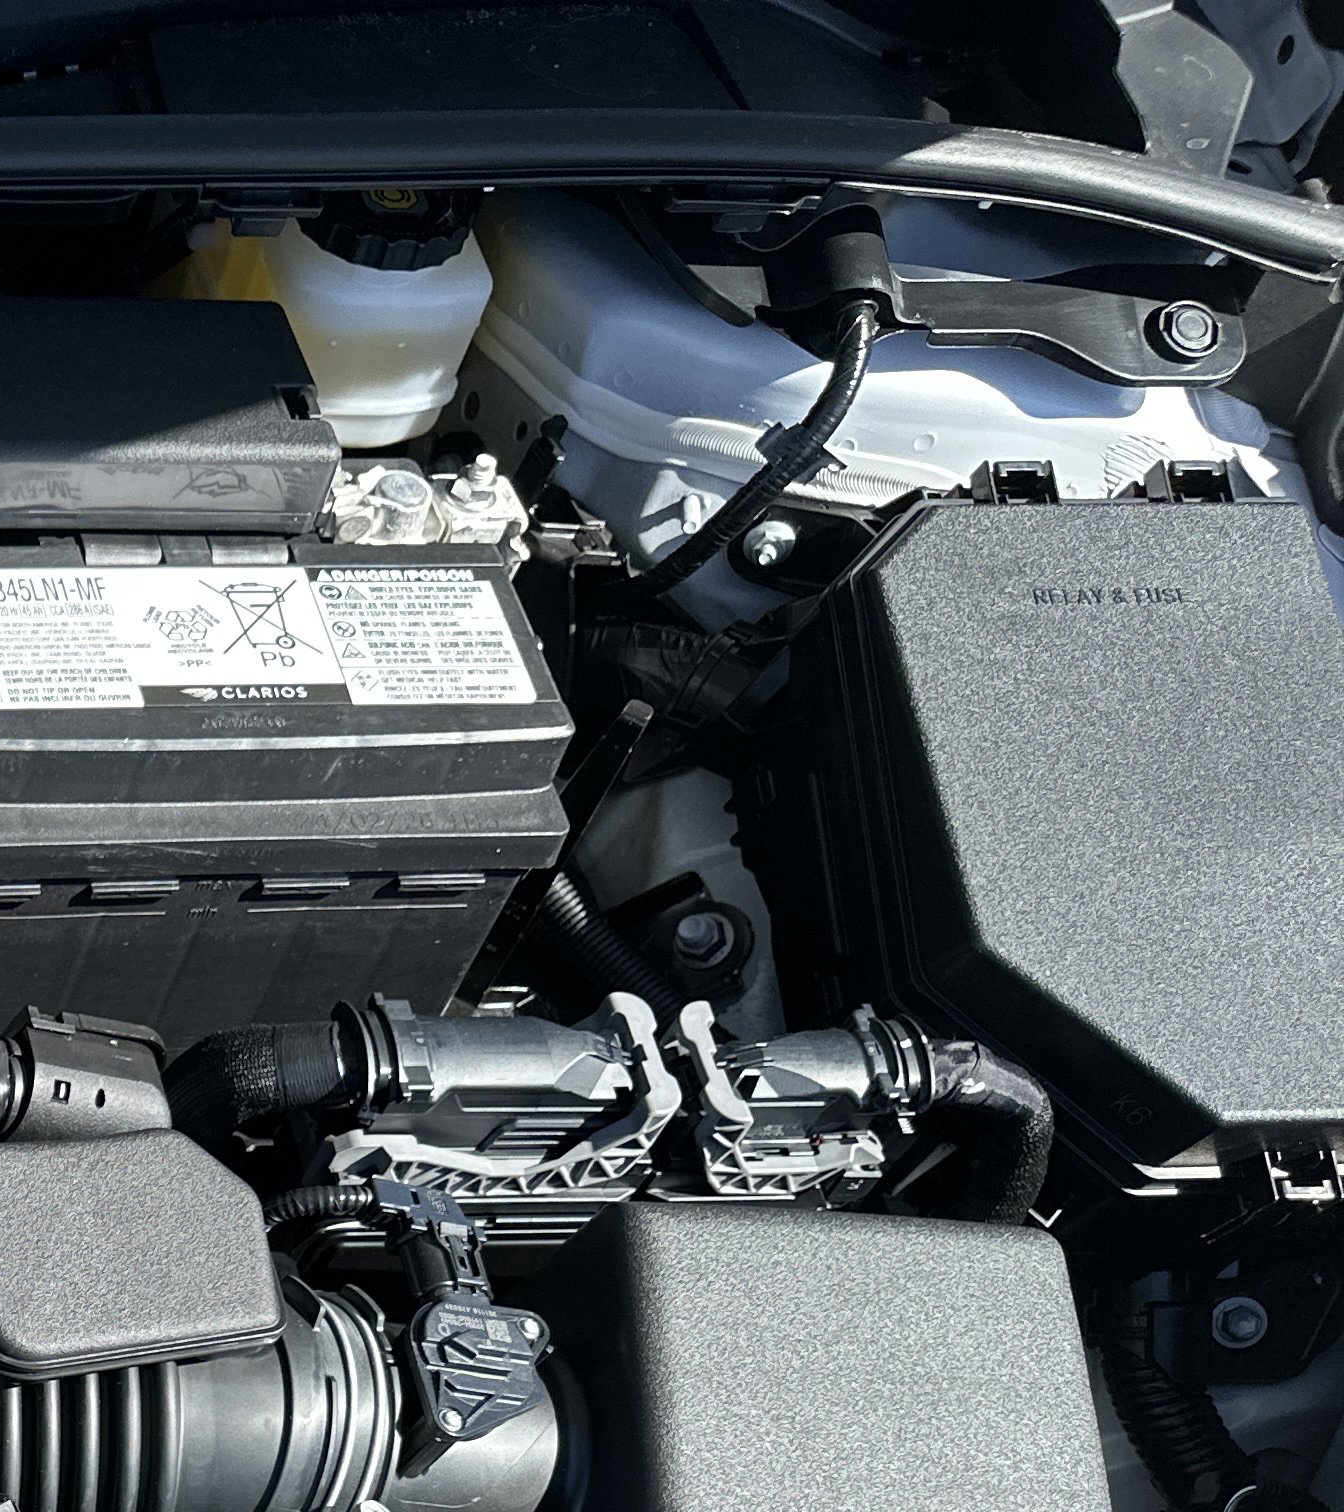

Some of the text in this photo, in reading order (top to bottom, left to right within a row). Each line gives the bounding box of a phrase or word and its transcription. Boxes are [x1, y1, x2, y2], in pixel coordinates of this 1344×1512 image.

[1032, 587, 1189, 605] RELAY & FUSE
[261, 651, 296, 667] Pb
[221, 686, 308, 700] CLARIOS
